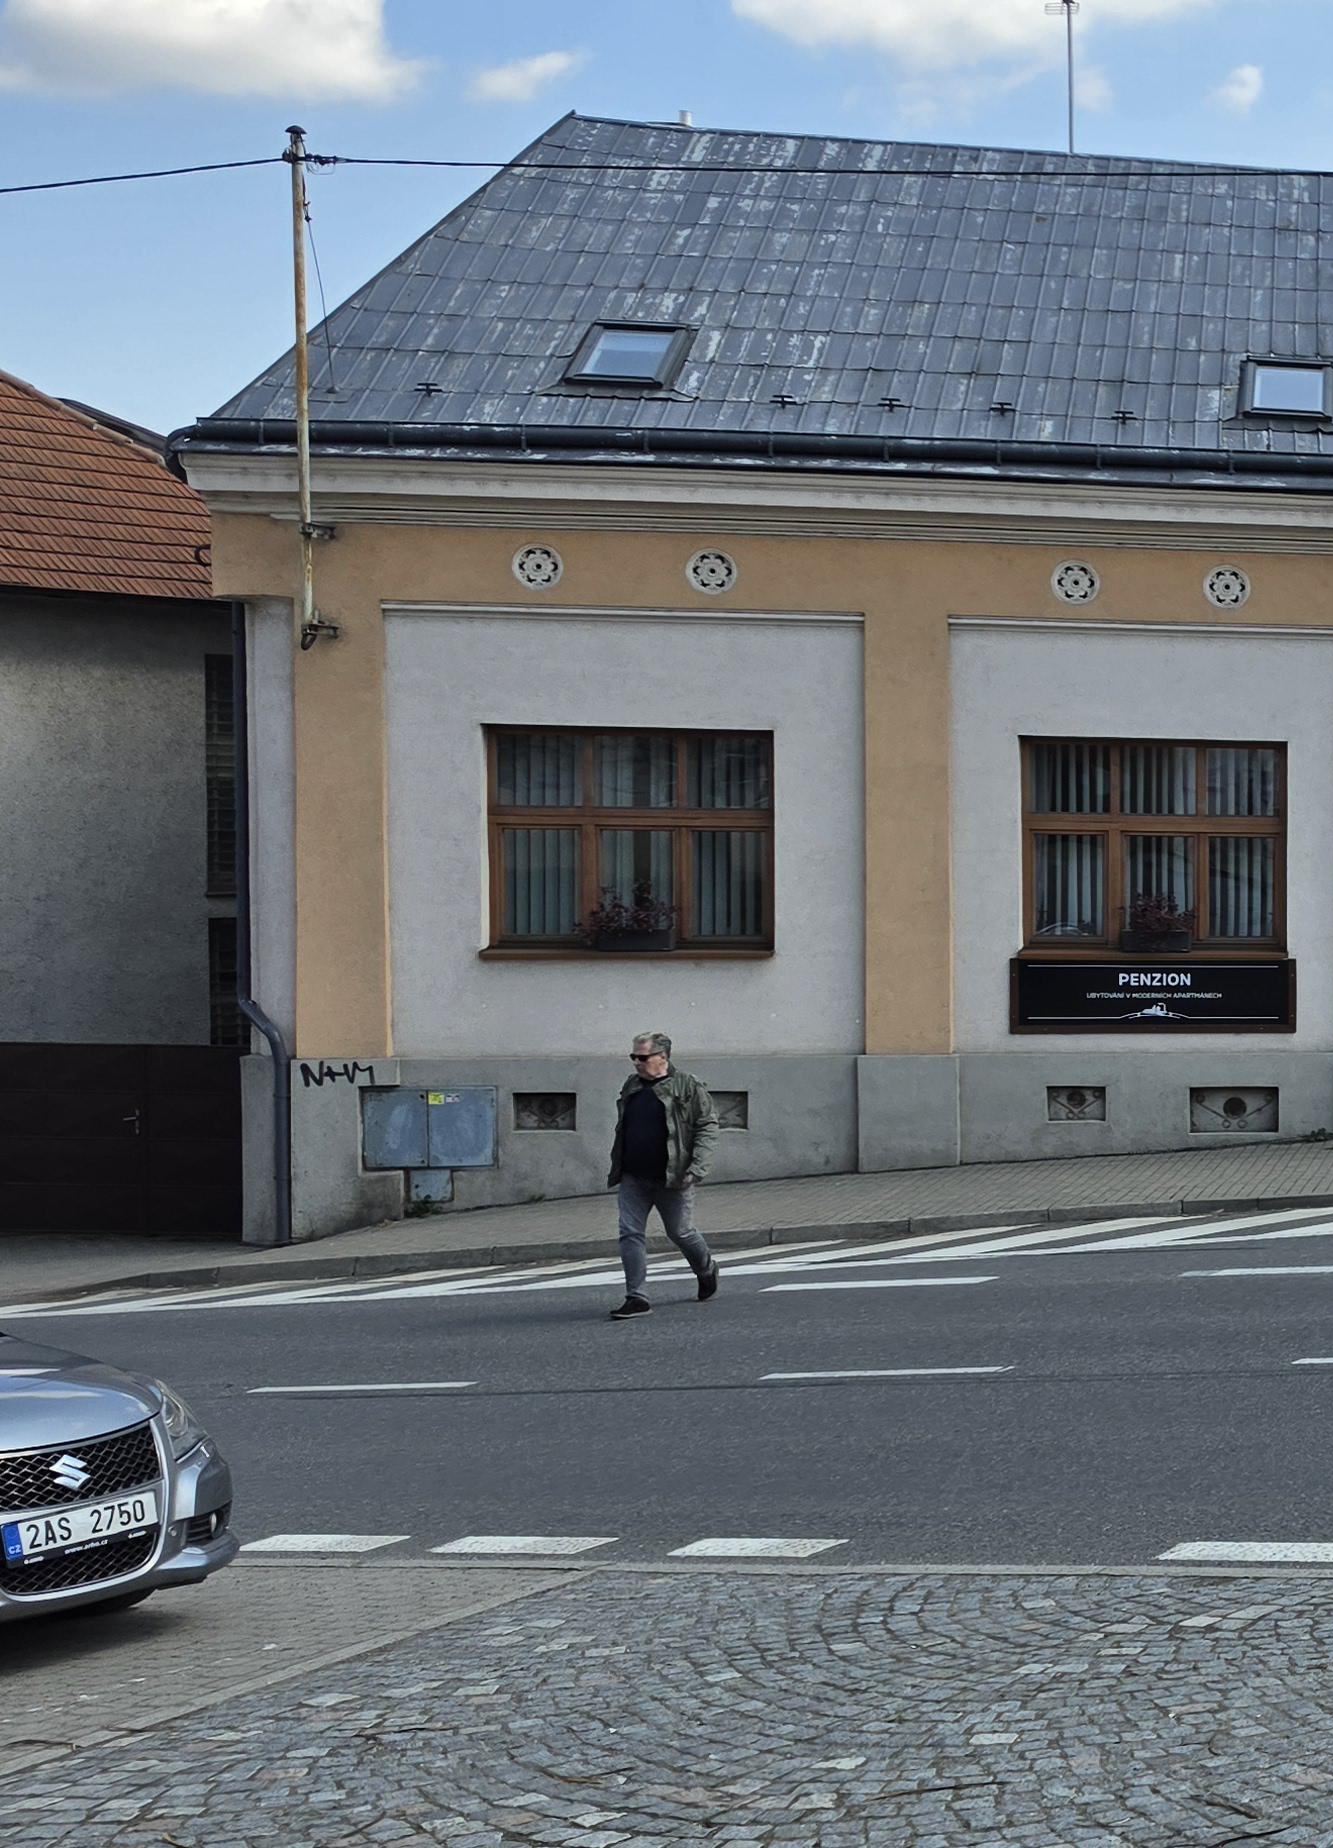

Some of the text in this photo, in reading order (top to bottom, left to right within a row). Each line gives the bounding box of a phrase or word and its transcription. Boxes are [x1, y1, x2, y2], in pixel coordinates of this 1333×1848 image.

[1118, 973, 1192, 987] PENZION
[26, 1499, 146, 1550] 2AS 2750
[8, 1544, 22, 1555] CZ
